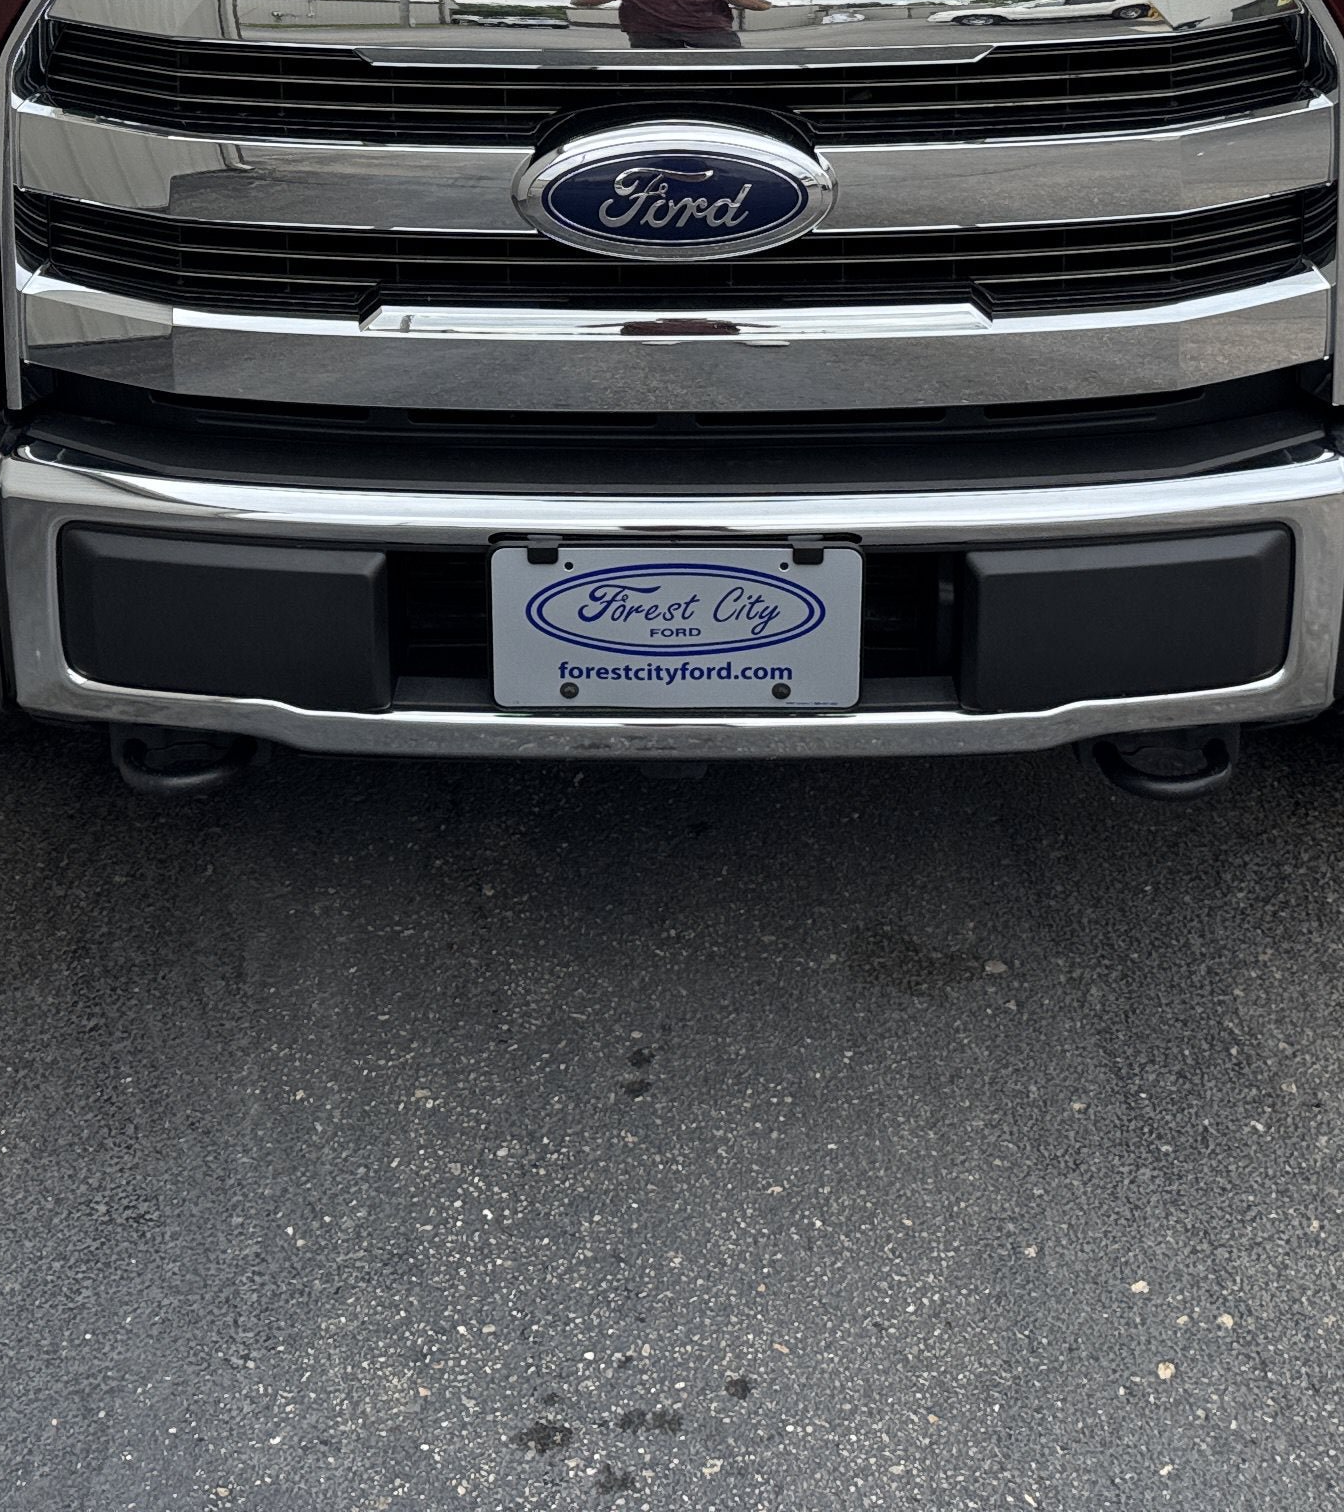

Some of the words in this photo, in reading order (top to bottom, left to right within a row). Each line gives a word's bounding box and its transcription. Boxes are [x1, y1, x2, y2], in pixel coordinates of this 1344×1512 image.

[599, 167, 752, 228] Ford
[578, 584, 701, 623] Forest
[712, 586, 781, 636] City
[649, 627, 702, 638] FORD
[558, 661, 793, 686] forestcityford.com
